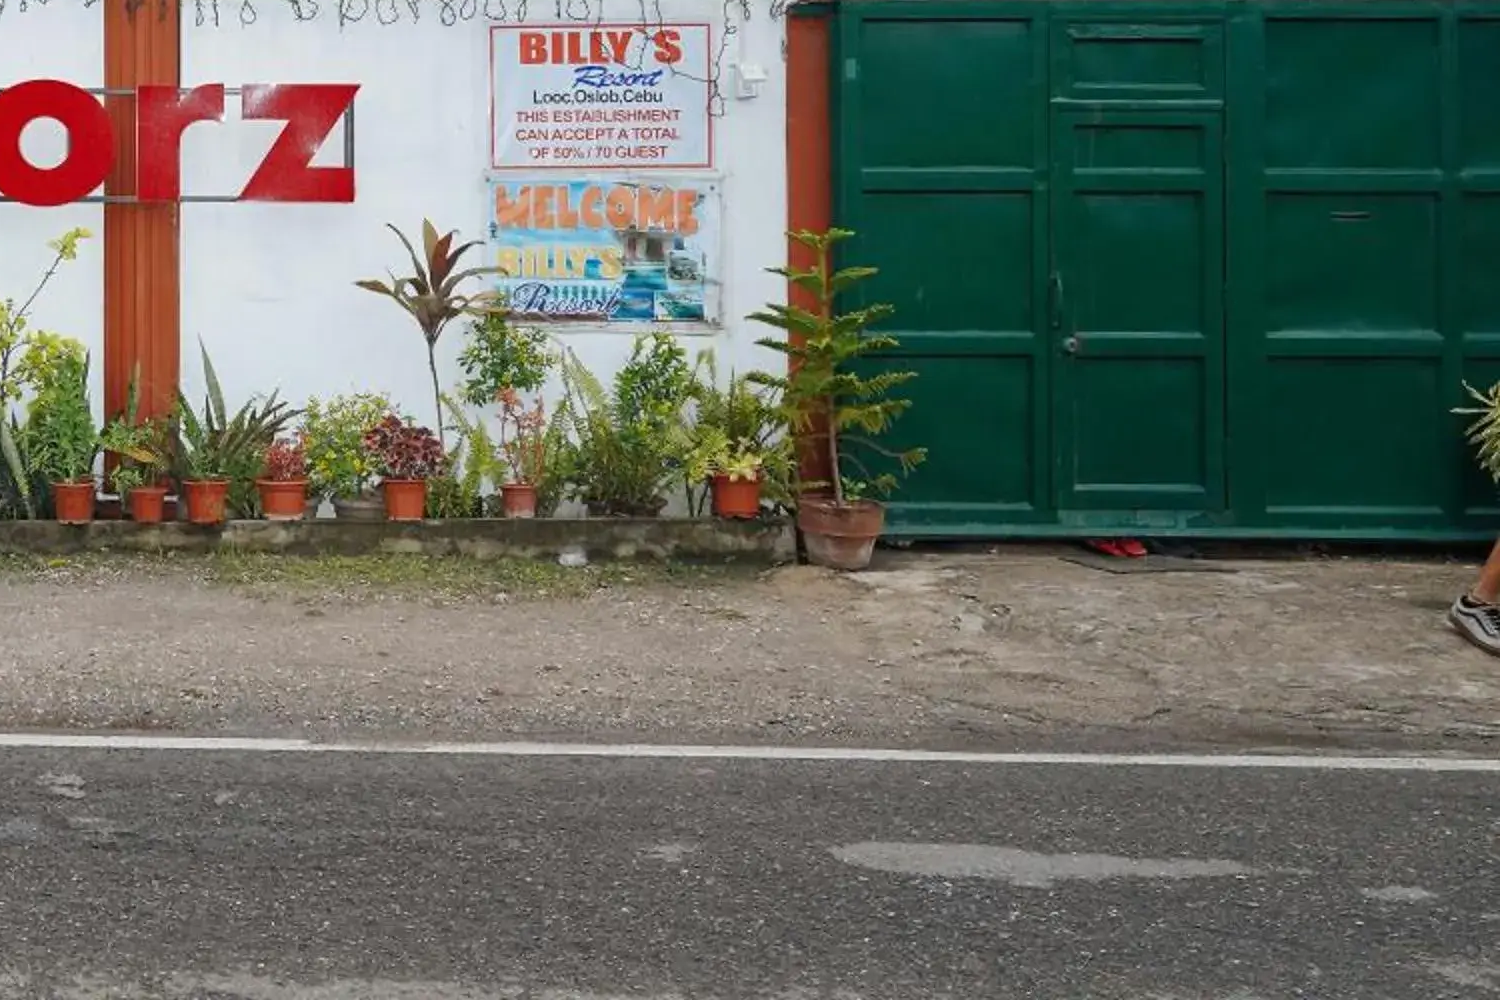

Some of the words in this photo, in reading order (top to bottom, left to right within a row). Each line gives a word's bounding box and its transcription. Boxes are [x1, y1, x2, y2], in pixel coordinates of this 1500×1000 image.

[519, 26, 682, 65] BILLY'S
[572, 65, 664, 88] Resort
[516, 109, 549, 123] THIS
[553, 109, 681, 123] ESTABLISHMENT
[515, 128, 549, 141] CAN
[551, 128, 615, 141] ACCEPT
[617, 128, 632, 140] A
[632, 128, 681, 140] TOTAL
[529, 146, 550, 159] OF
[615, 145, 668, 158] GUEST
[495, 184, 699, 235] WELCOME
